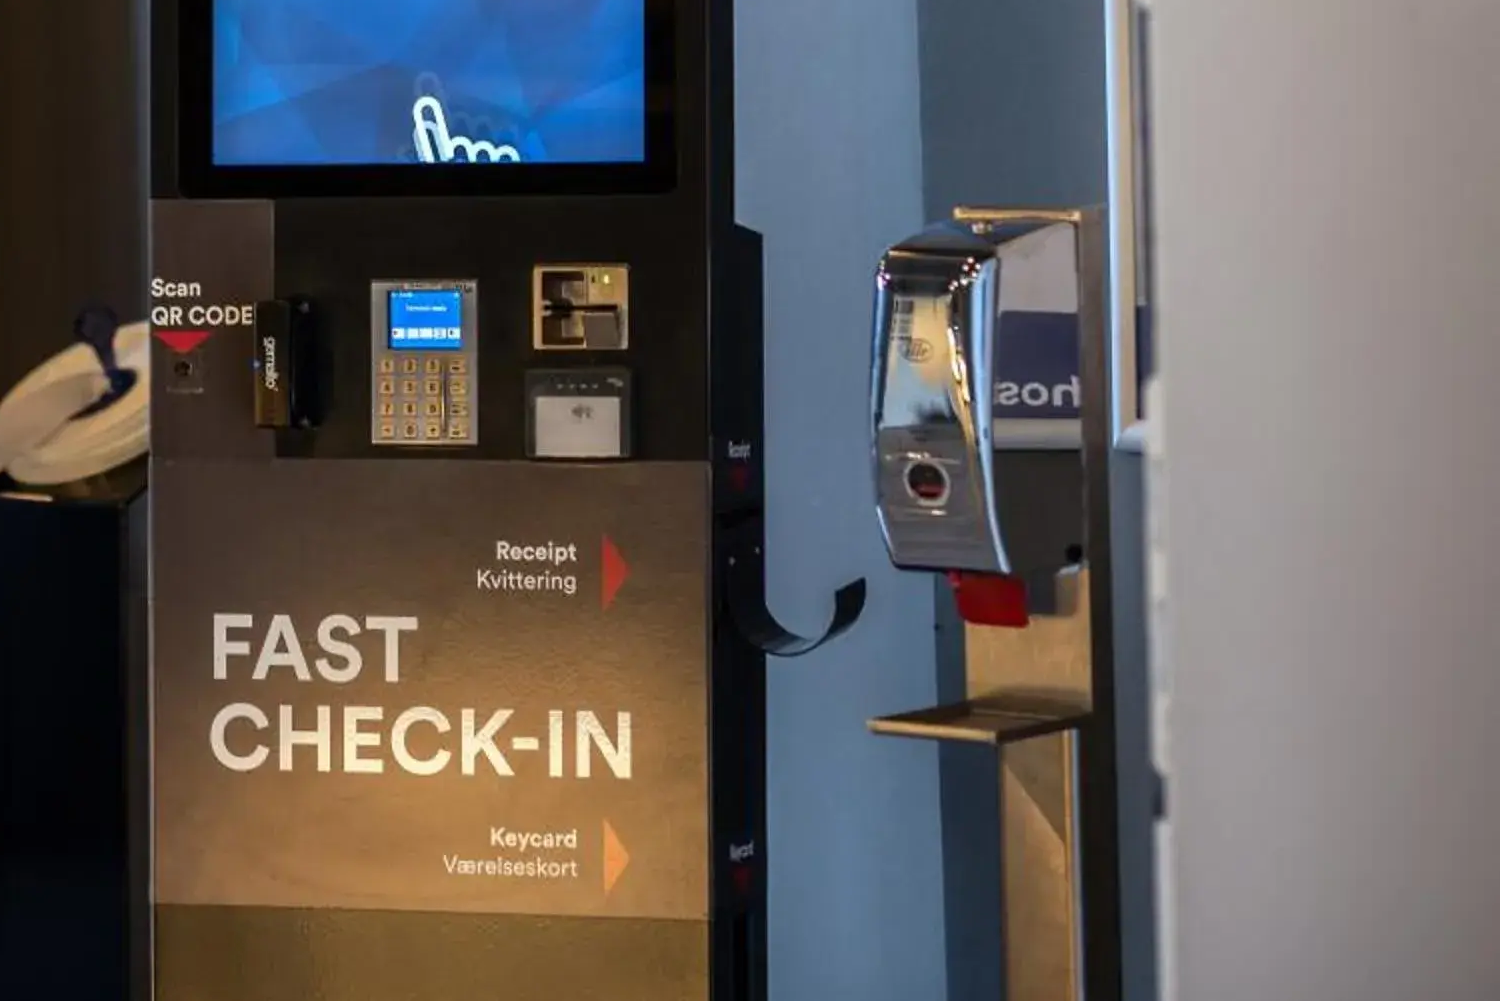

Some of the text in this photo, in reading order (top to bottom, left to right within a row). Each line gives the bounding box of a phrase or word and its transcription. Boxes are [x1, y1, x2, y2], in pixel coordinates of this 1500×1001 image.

[152, 279, 200, 297] Scan
[152, 306, 252, 325] QR CODE
[497, 541, 576, 565] Receipt
[478, 570, 576, 594] Kvittering
[214, 614, 418, 683] FAST
[210, 702, 632, 780] CHECK-IN
[491, 828, 576, 851] Keycard
[444, 855, 577, 876] Værelseskort
